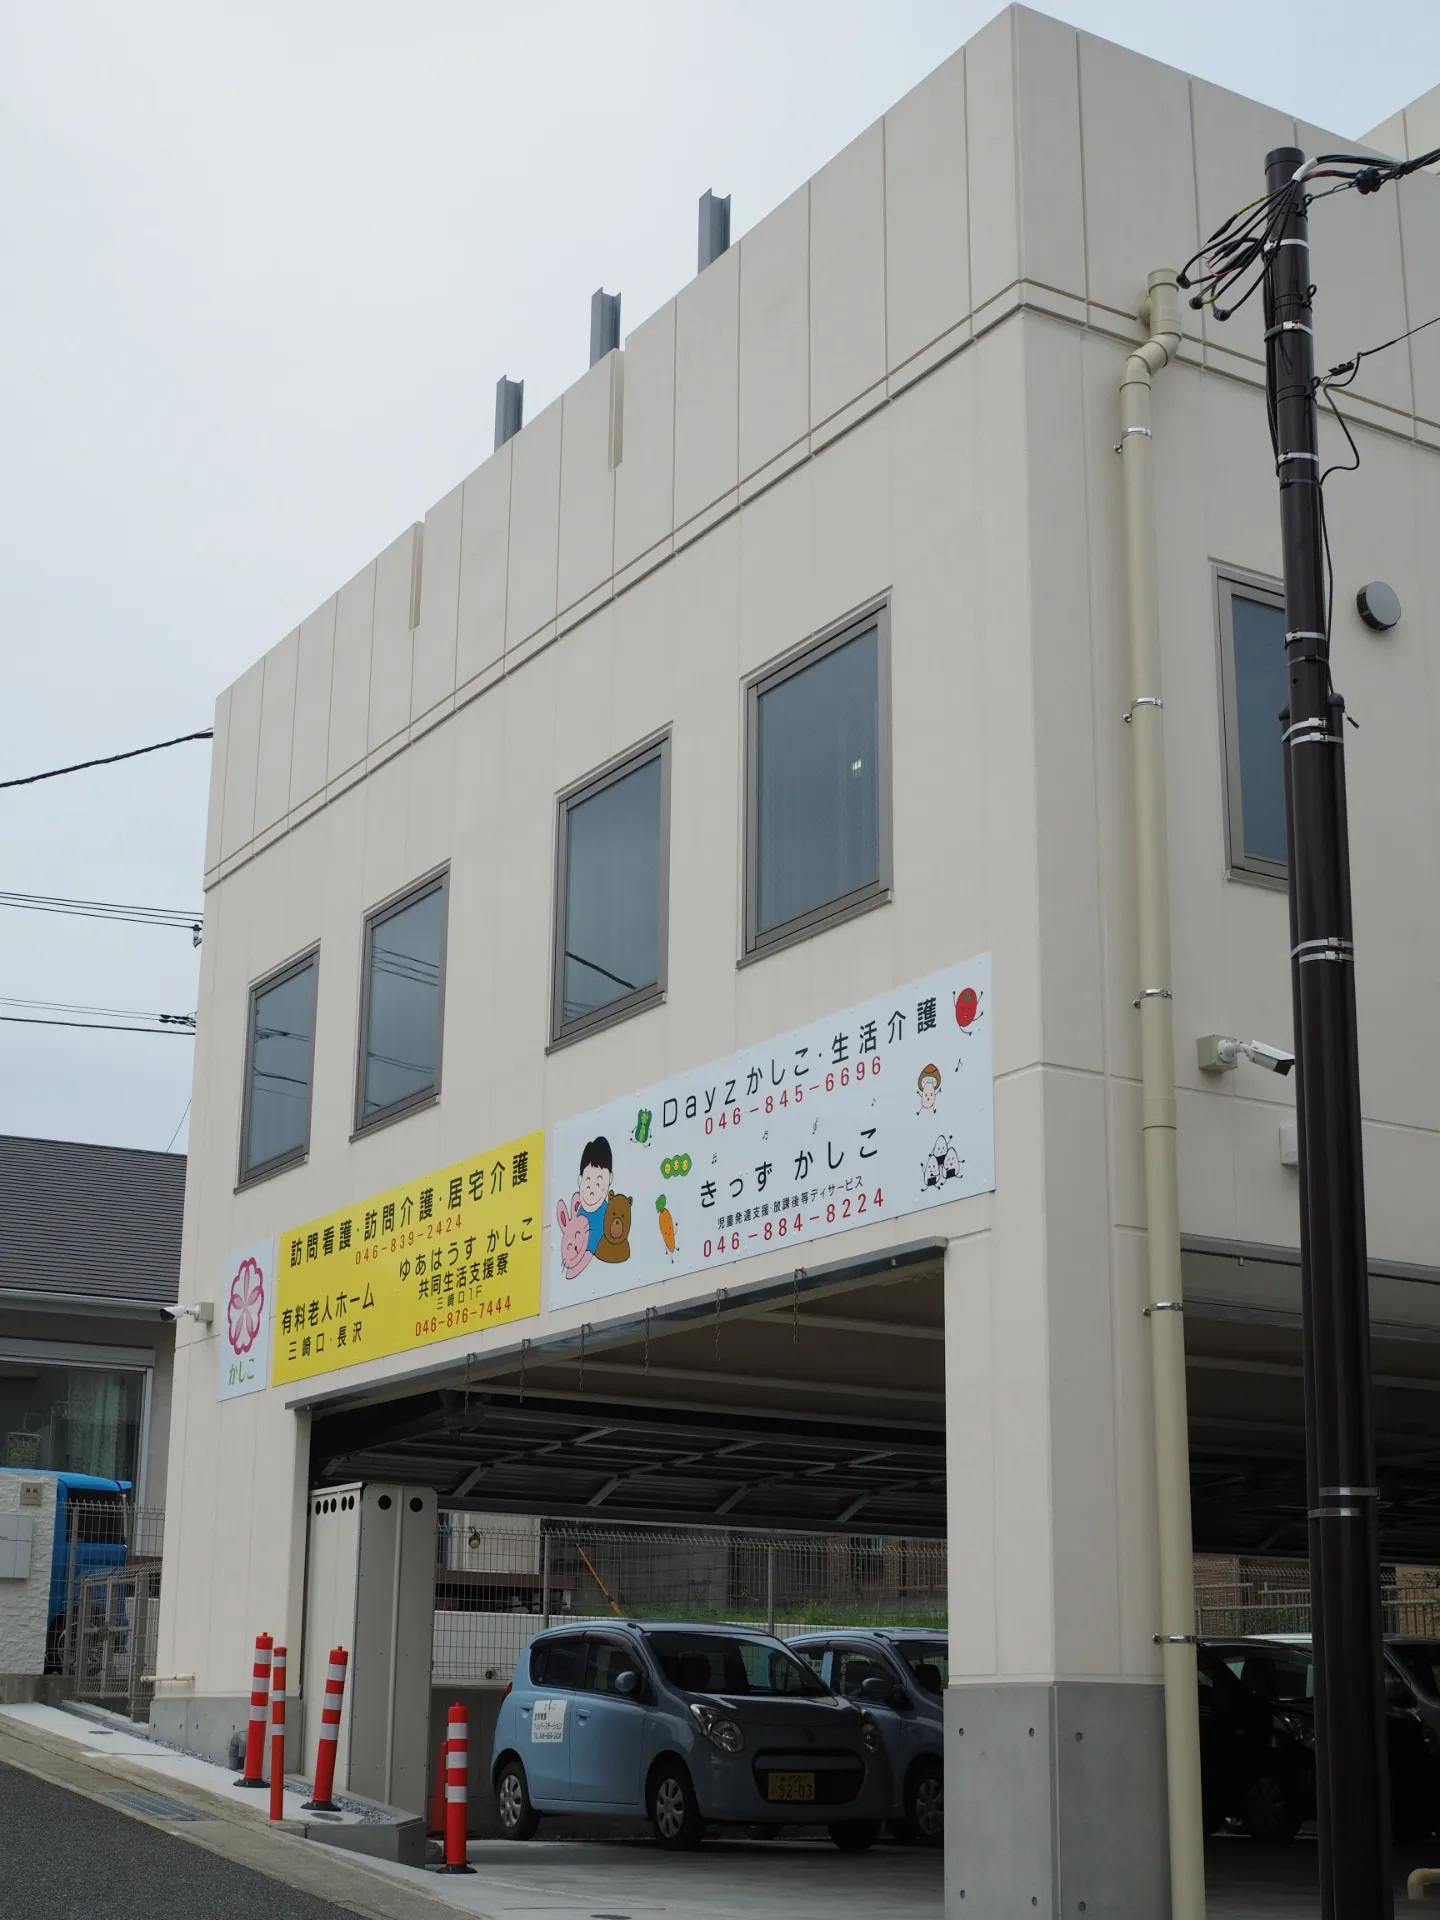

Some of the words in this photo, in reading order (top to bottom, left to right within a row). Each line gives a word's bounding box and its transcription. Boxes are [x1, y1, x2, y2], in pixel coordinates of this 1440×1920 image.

[704, 1055, 881, 1135] 046-845-6696
[700, 1161, 773, 1208] きっず
[794, 1127, 878, 1181] かしこ
[290, 1151, 528, 1268] 訪問看護・訪問介護・居宅介護
[355, 1213, 462, 1265] 046-839-2424
[703, 1187, 884, 1258] 046-884-8224
[399, 1235, 477, 1282] ゆあはうす
[486, 1217, 533, 1253] かしこ
[418, 1252, 509, 1300] 共同生活支援寮
[282, 1282, 375, 1336] 有料老人ホーム
[415, 1295, 511, 1337] 046-876-7444
[228, 1358, 255, 1386] かしこ
